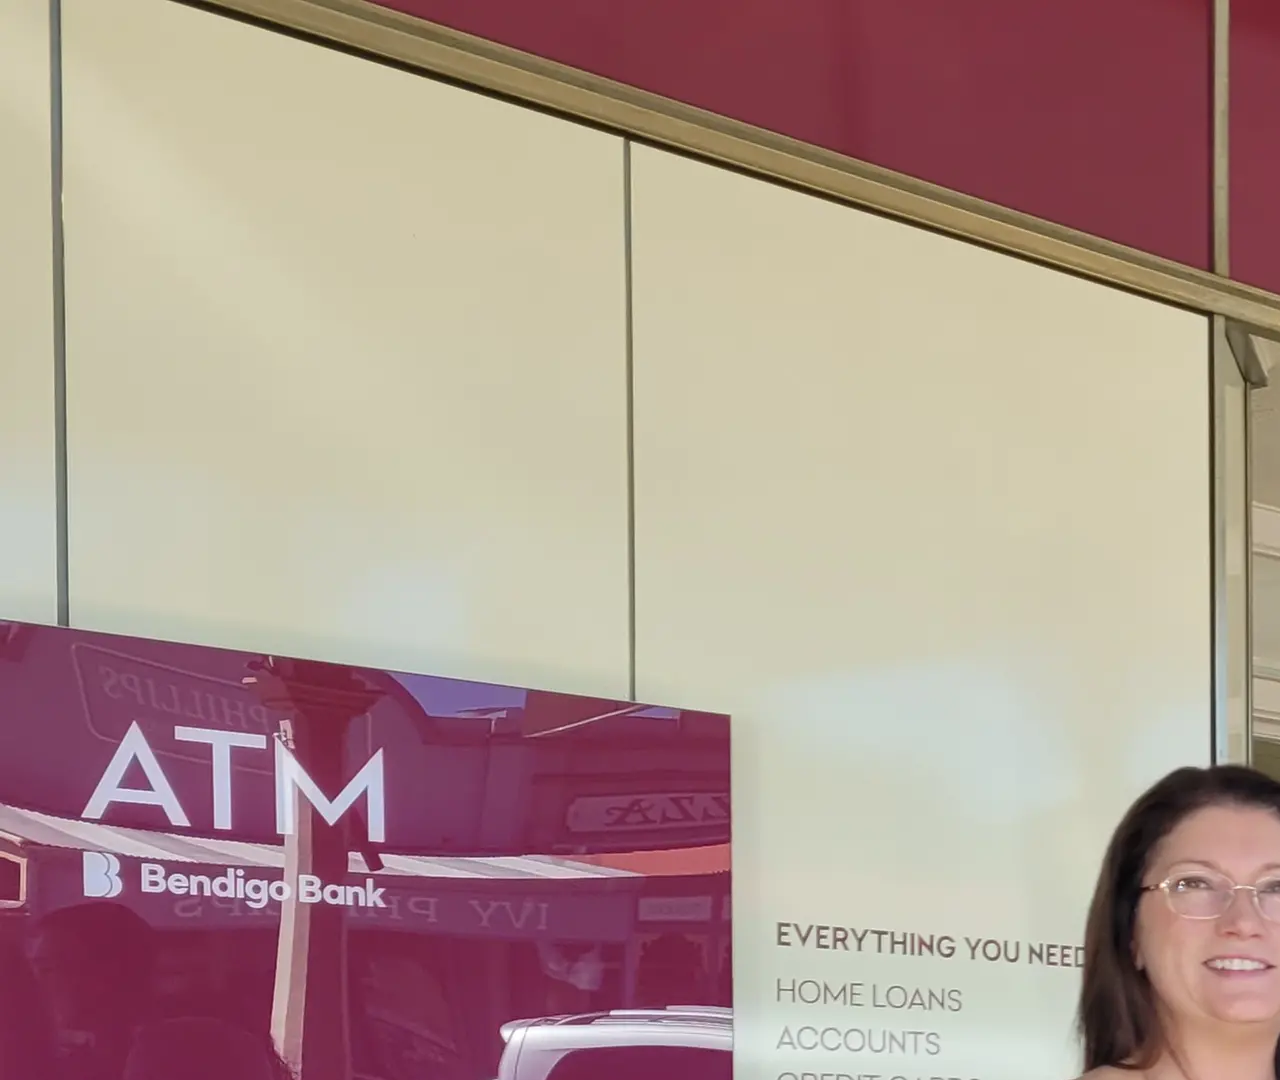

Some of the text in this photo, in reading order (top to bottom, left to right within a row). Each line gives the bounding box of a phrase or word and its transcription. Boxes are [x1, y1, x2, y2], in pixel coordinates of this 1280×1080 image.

[81, 720, 385, 844] ATM
[140, 861, 292, 909] Bendigo
[298, 873, 387, 909] Bank
[776, 921, 956, 959] EVERYTHING
[964, 936, 1021, 963] YOU
[776, 978, 963, 1012] HOME LOANS
[776, 1026, 941, 1056] ACCOUNTS
